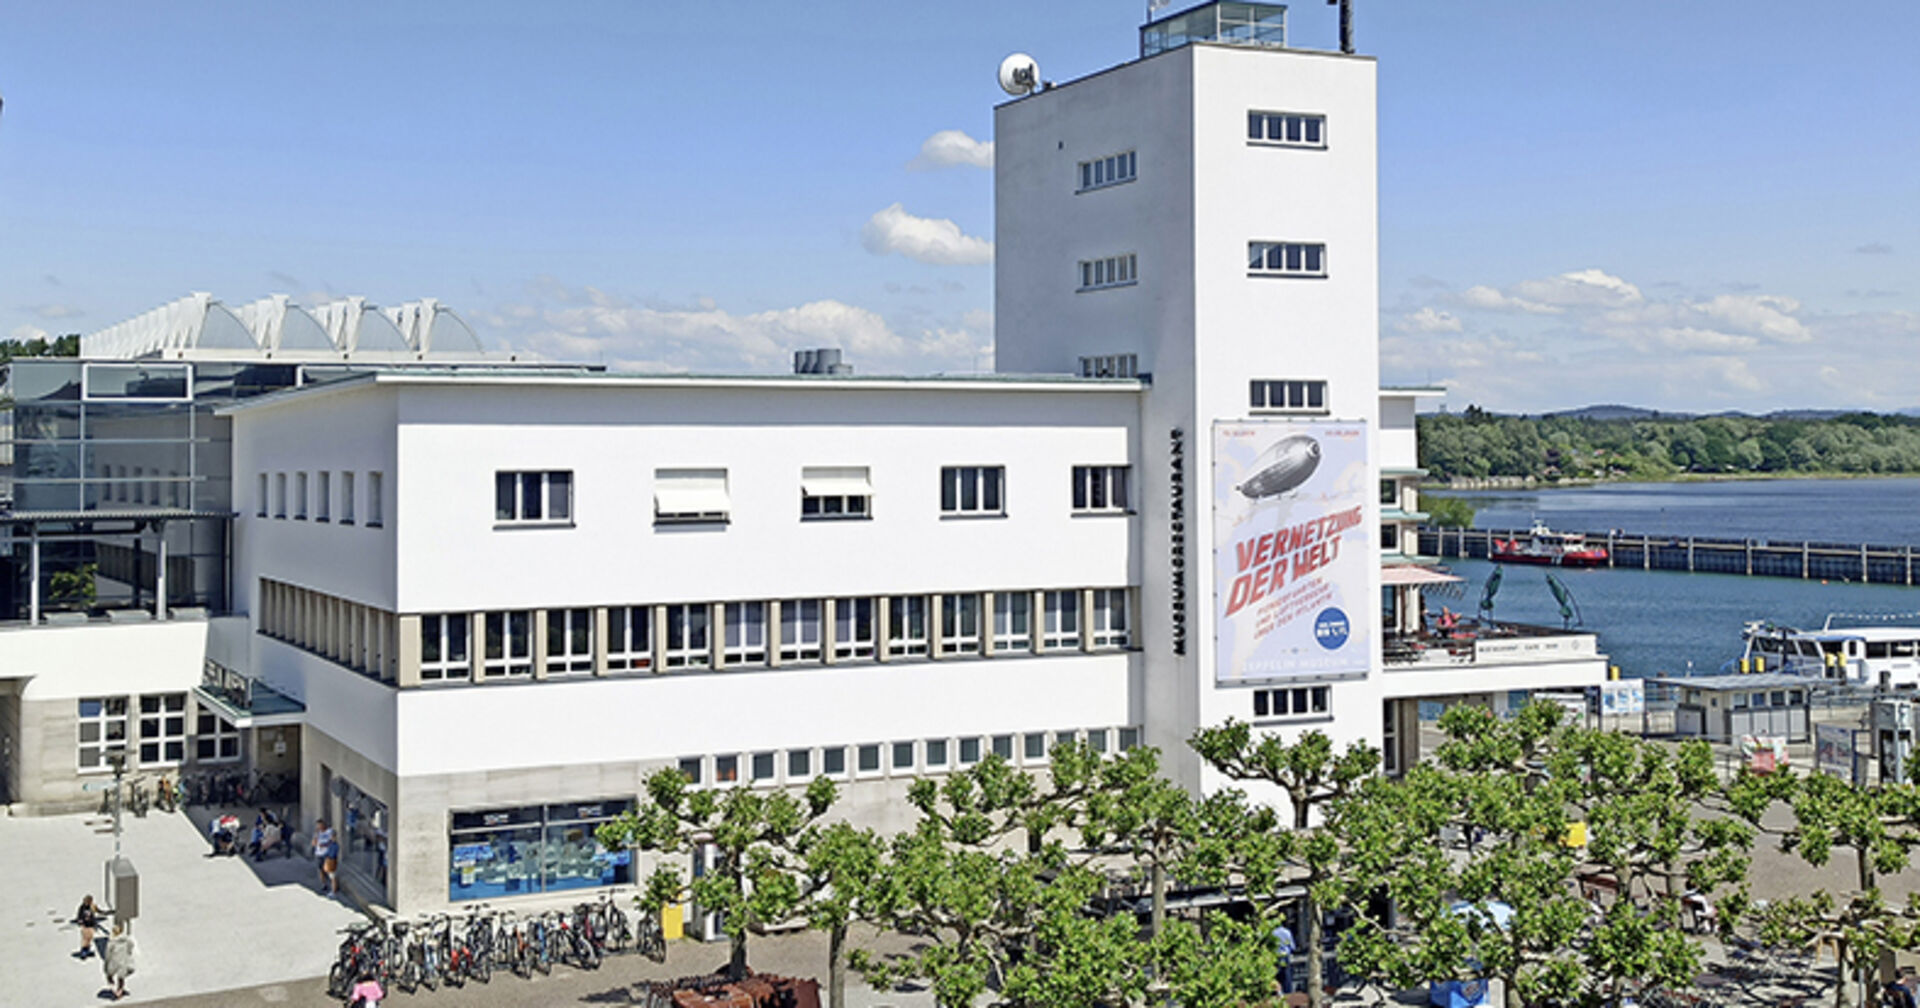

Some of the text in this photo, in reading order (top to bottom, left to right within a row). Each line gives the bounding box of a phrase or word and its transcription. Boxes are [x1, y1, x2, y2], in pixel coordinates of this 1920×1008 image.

[1225, 535, 1341, 617] DER WELT
[1236, 505, 1362, 573] VERNETZUNG
